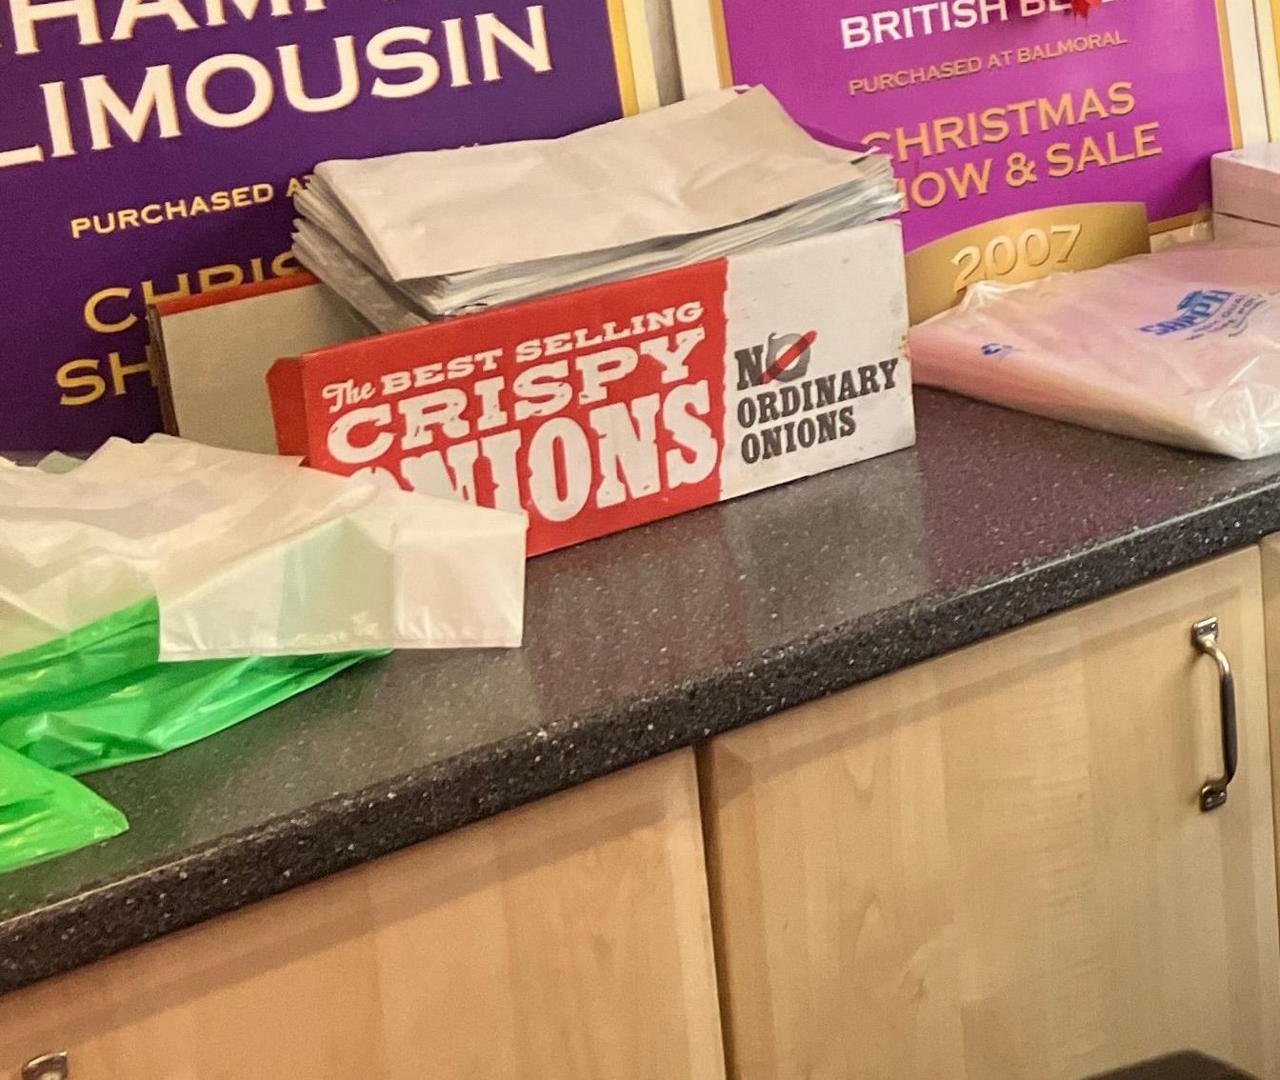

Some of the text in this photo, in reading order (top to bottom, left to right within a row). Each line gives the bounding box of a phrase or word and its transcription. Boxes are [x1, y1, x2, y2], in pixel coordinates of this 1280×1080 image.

[849, 29, 1129, 97] PURCHASED AT BALMORAL
[1004, 151, 1038, 188] &
[1045, 122, 1164, 179] SALE
[70, 182, 274, 240] PURCHASED
[951, 223, 1083, 294] 2007
[321, 300, 704, 414] The BEST SELLING
[326, 325, 706, 465] CRISPY
[736, 357, 900, 429] ORDINARY
[351, 379, 718, 522] NIONS
[740, 404, 858, 465] ONIONS
